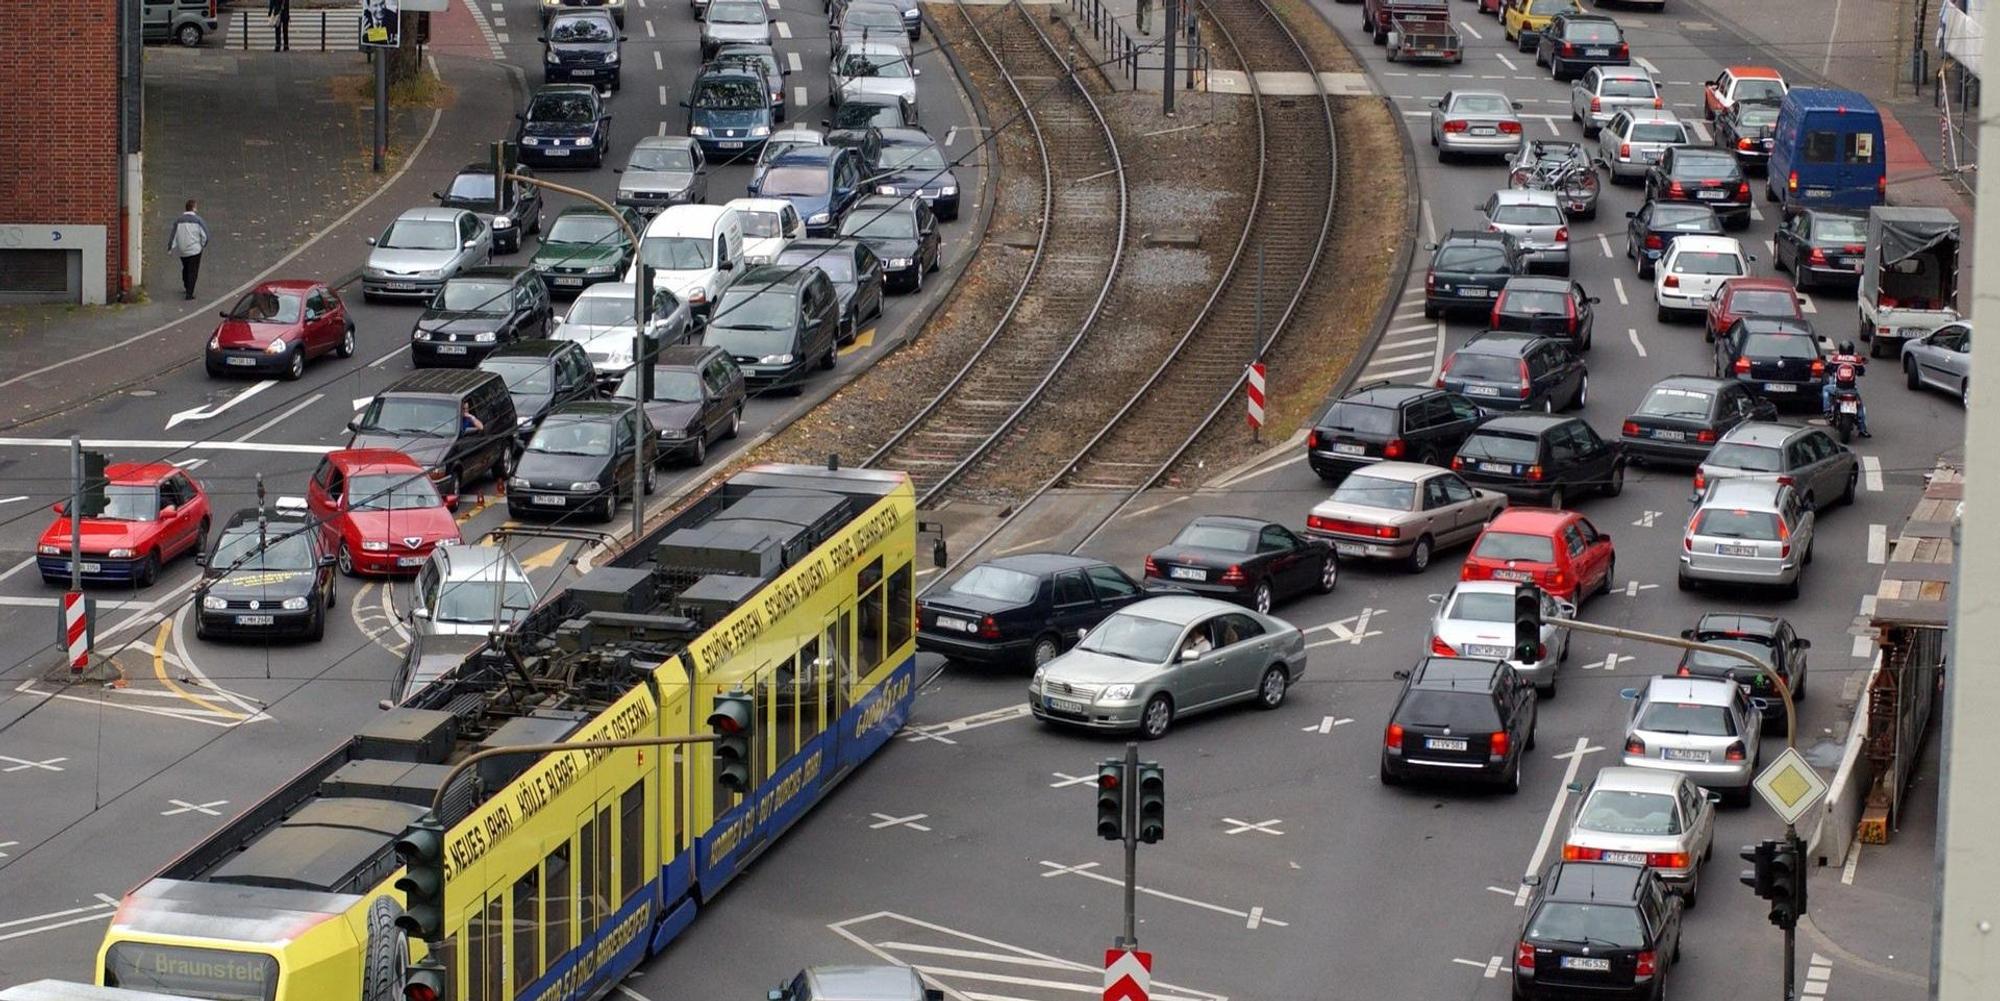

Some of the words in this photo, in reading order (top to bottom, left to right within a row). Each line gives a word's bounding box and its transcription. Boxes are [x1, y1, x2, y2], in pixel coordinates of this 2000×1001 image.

[701, 630, 734, 673] SCHÖNE
[732, 609, 764, 652] FERIEN!
[764, 583, 800, 625] SCHÖNEN
[798, 558, 830, 601] ADVENT!
[449, 826, 486, 875] NEUES
[483, 803, 514, 848] JAHR!
[516, 777, 547, 822] KÖLLE
[545, 751, 579, 803] ALAAF!
[585, 725, 613, 769] FROHE
[612, 696, 651, 743] OSTERN!
[155, 952, 266, 982] Braunsfeld
